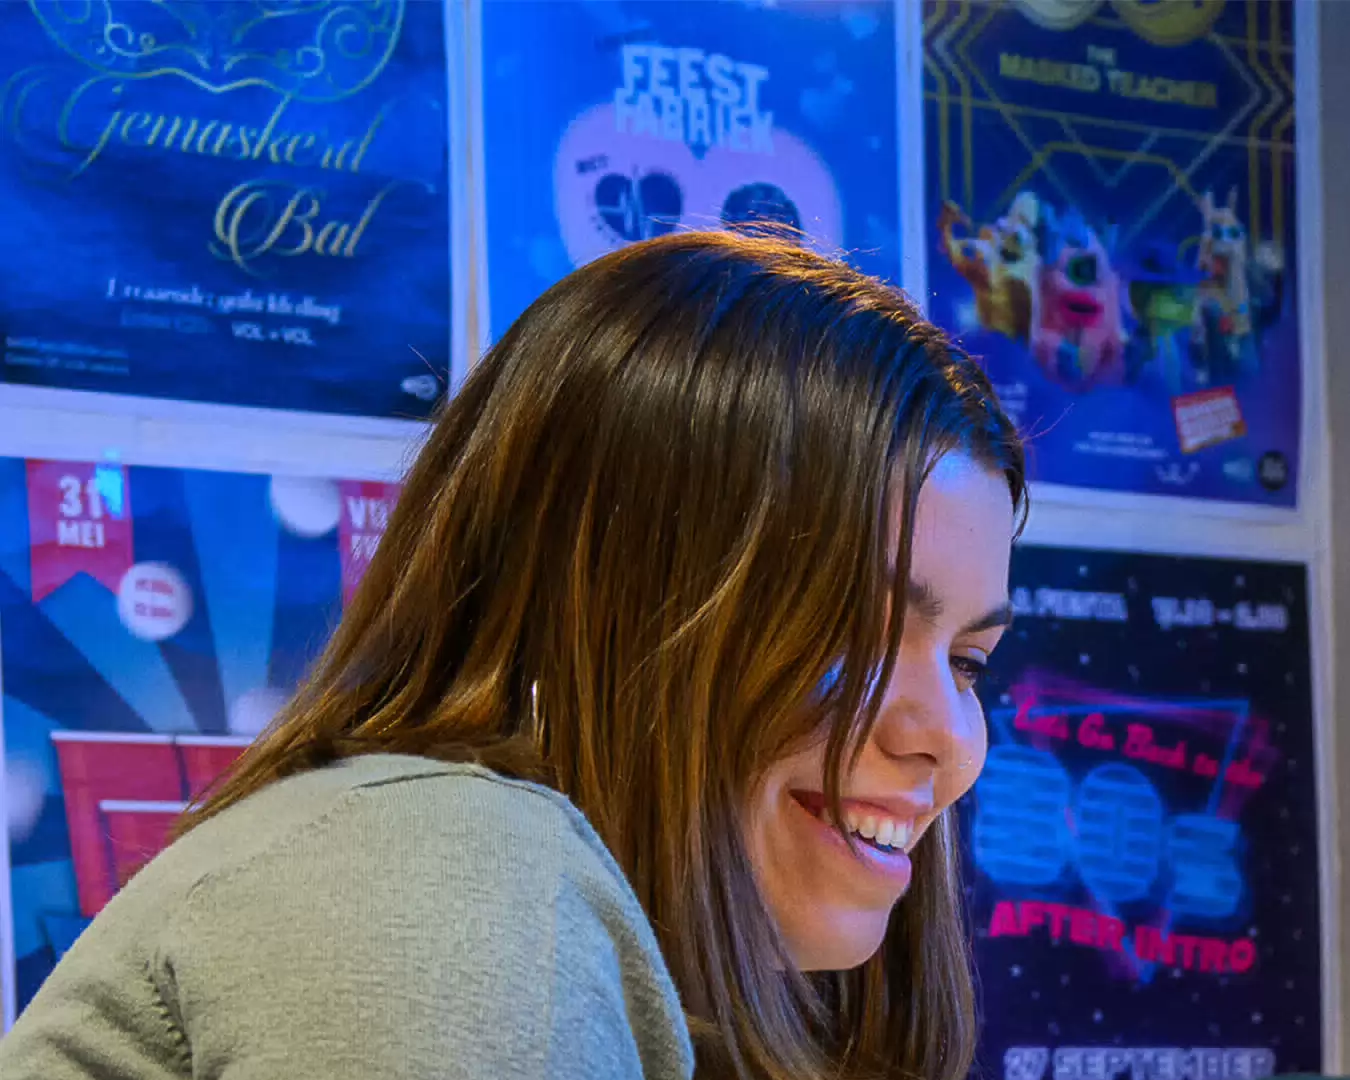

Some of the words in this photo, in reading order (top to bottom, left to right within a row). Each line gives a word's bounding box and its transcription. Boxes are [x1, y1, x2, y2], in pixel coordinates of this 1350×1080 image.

[622, 43, 770, 108] FEEST
[1107, 69, 1217, 108] TEACHER
[614, 86, 775, 156] FABRIEK
[208, 178, 390, 277] Bal
[57, 519, 105, 548] MEI
[988, 899, 1126, 952] AFTER
[1135, 925, 1257, 974] INTRO
